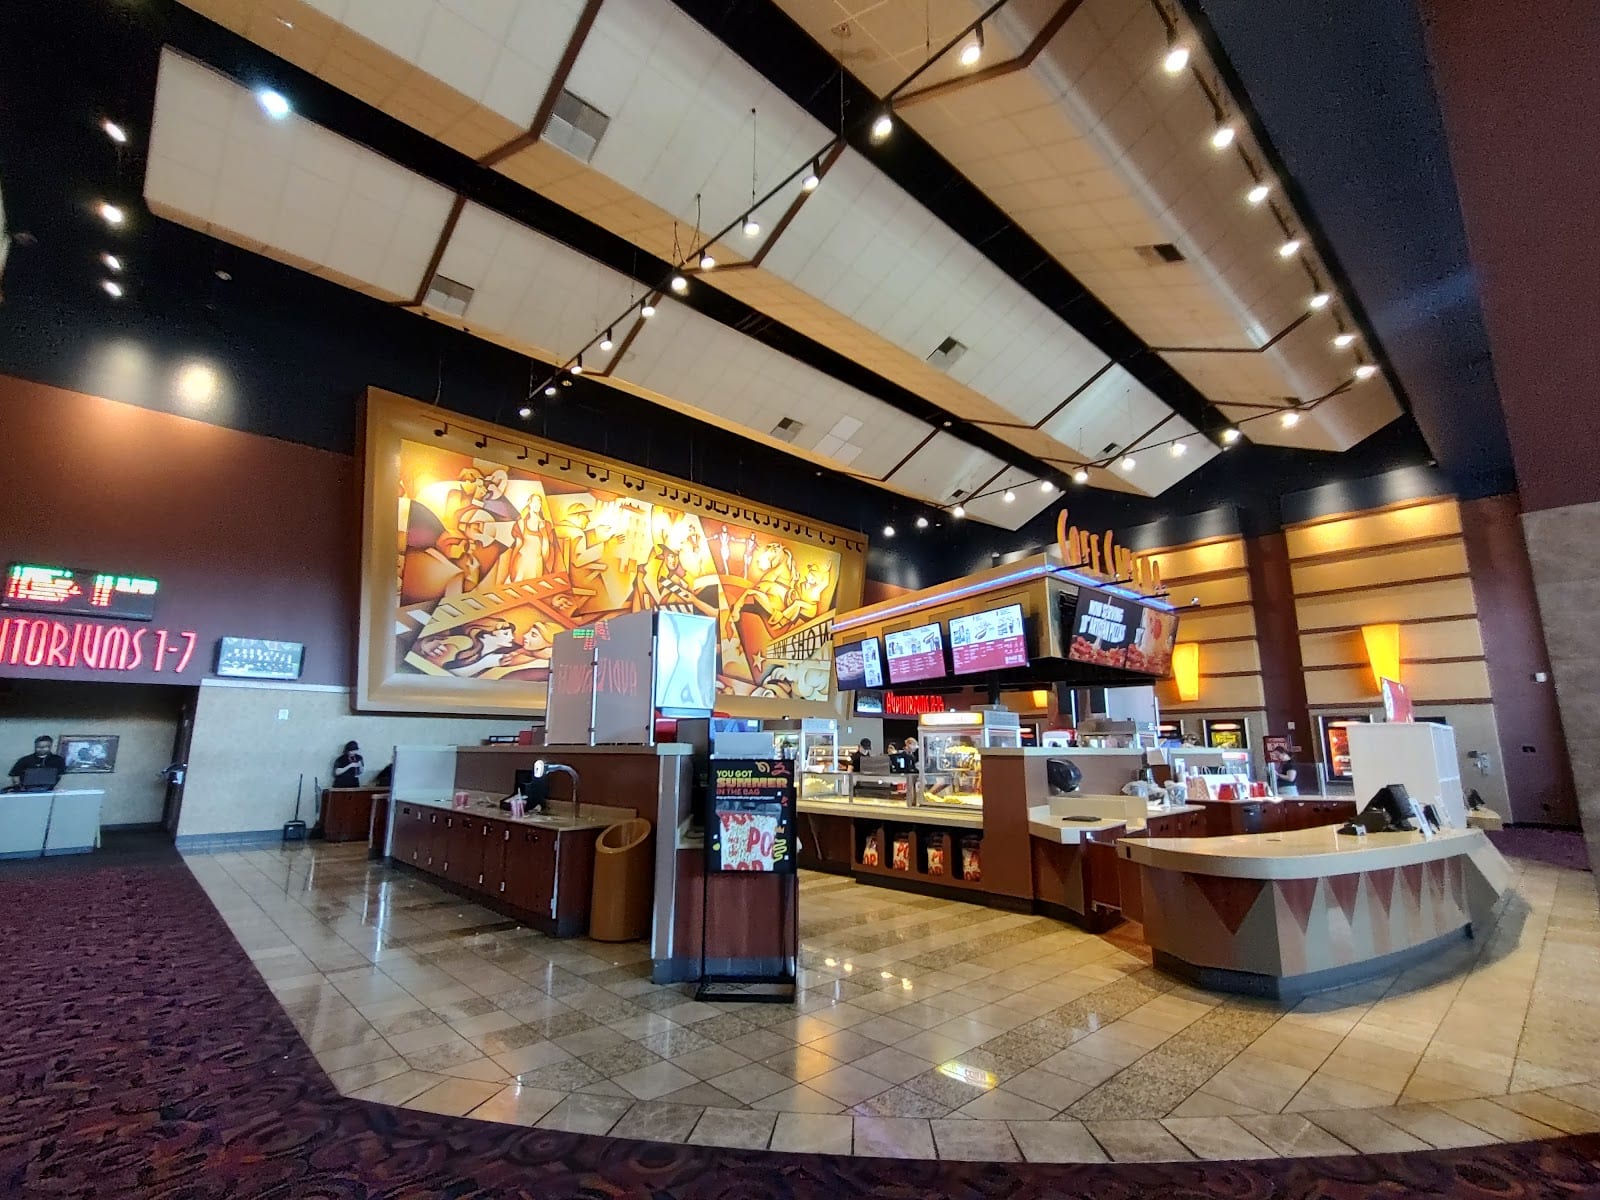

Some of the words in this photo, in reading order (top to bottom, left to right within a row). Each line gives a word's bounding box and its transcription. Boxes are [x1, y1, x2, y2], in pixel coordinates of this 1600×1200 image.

[0, 618, 147, 670] ITORIUMS
[154, 630, 197, 673] 1-7
[886, 691, 930, 715] AUDITORIUMS
[716, 770, 734, 778] YOU
[735, 770, 753, 778] GOT
[716, 777, 788, 788] SUMMER
